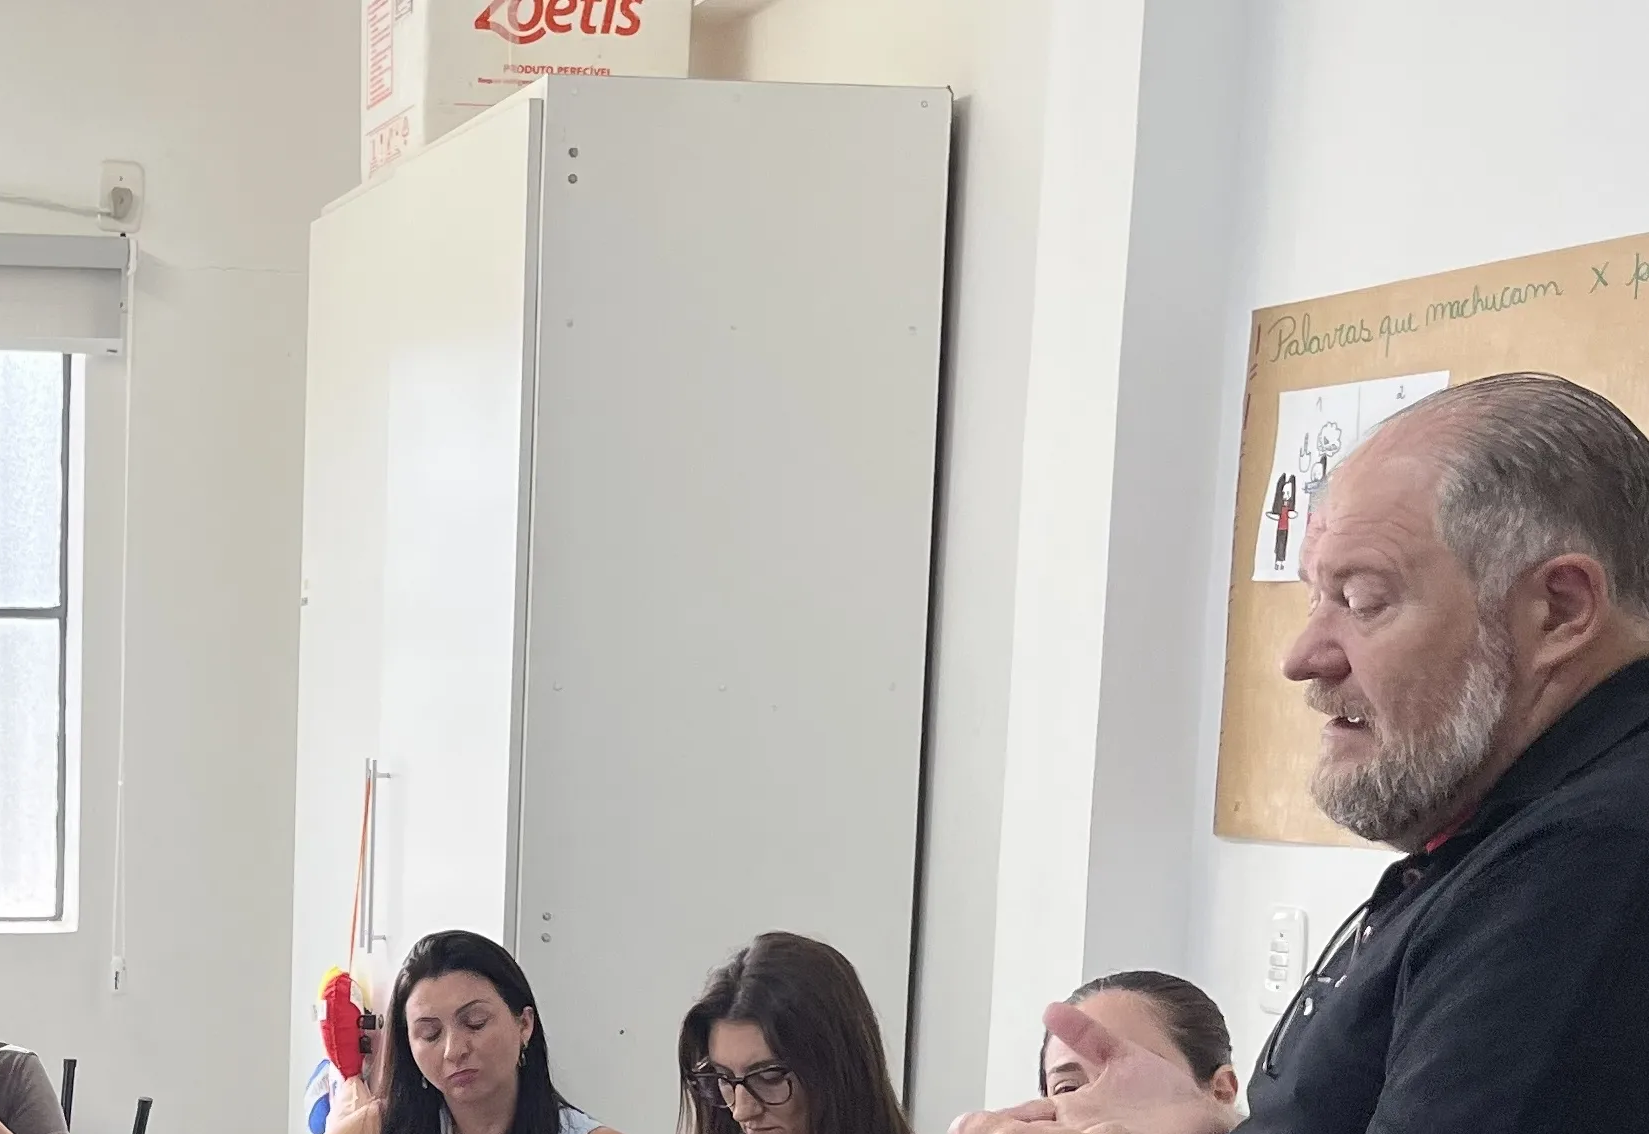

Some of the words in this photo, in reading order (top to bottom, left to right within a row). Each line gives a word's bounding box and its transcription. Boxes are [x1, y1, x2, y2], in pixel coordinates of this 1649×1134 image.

[503, 64, 554, 75] PRODUTO
[1268, 312, 1373, 362] Palavras
[1425, 280, 1564, 327] machucam
